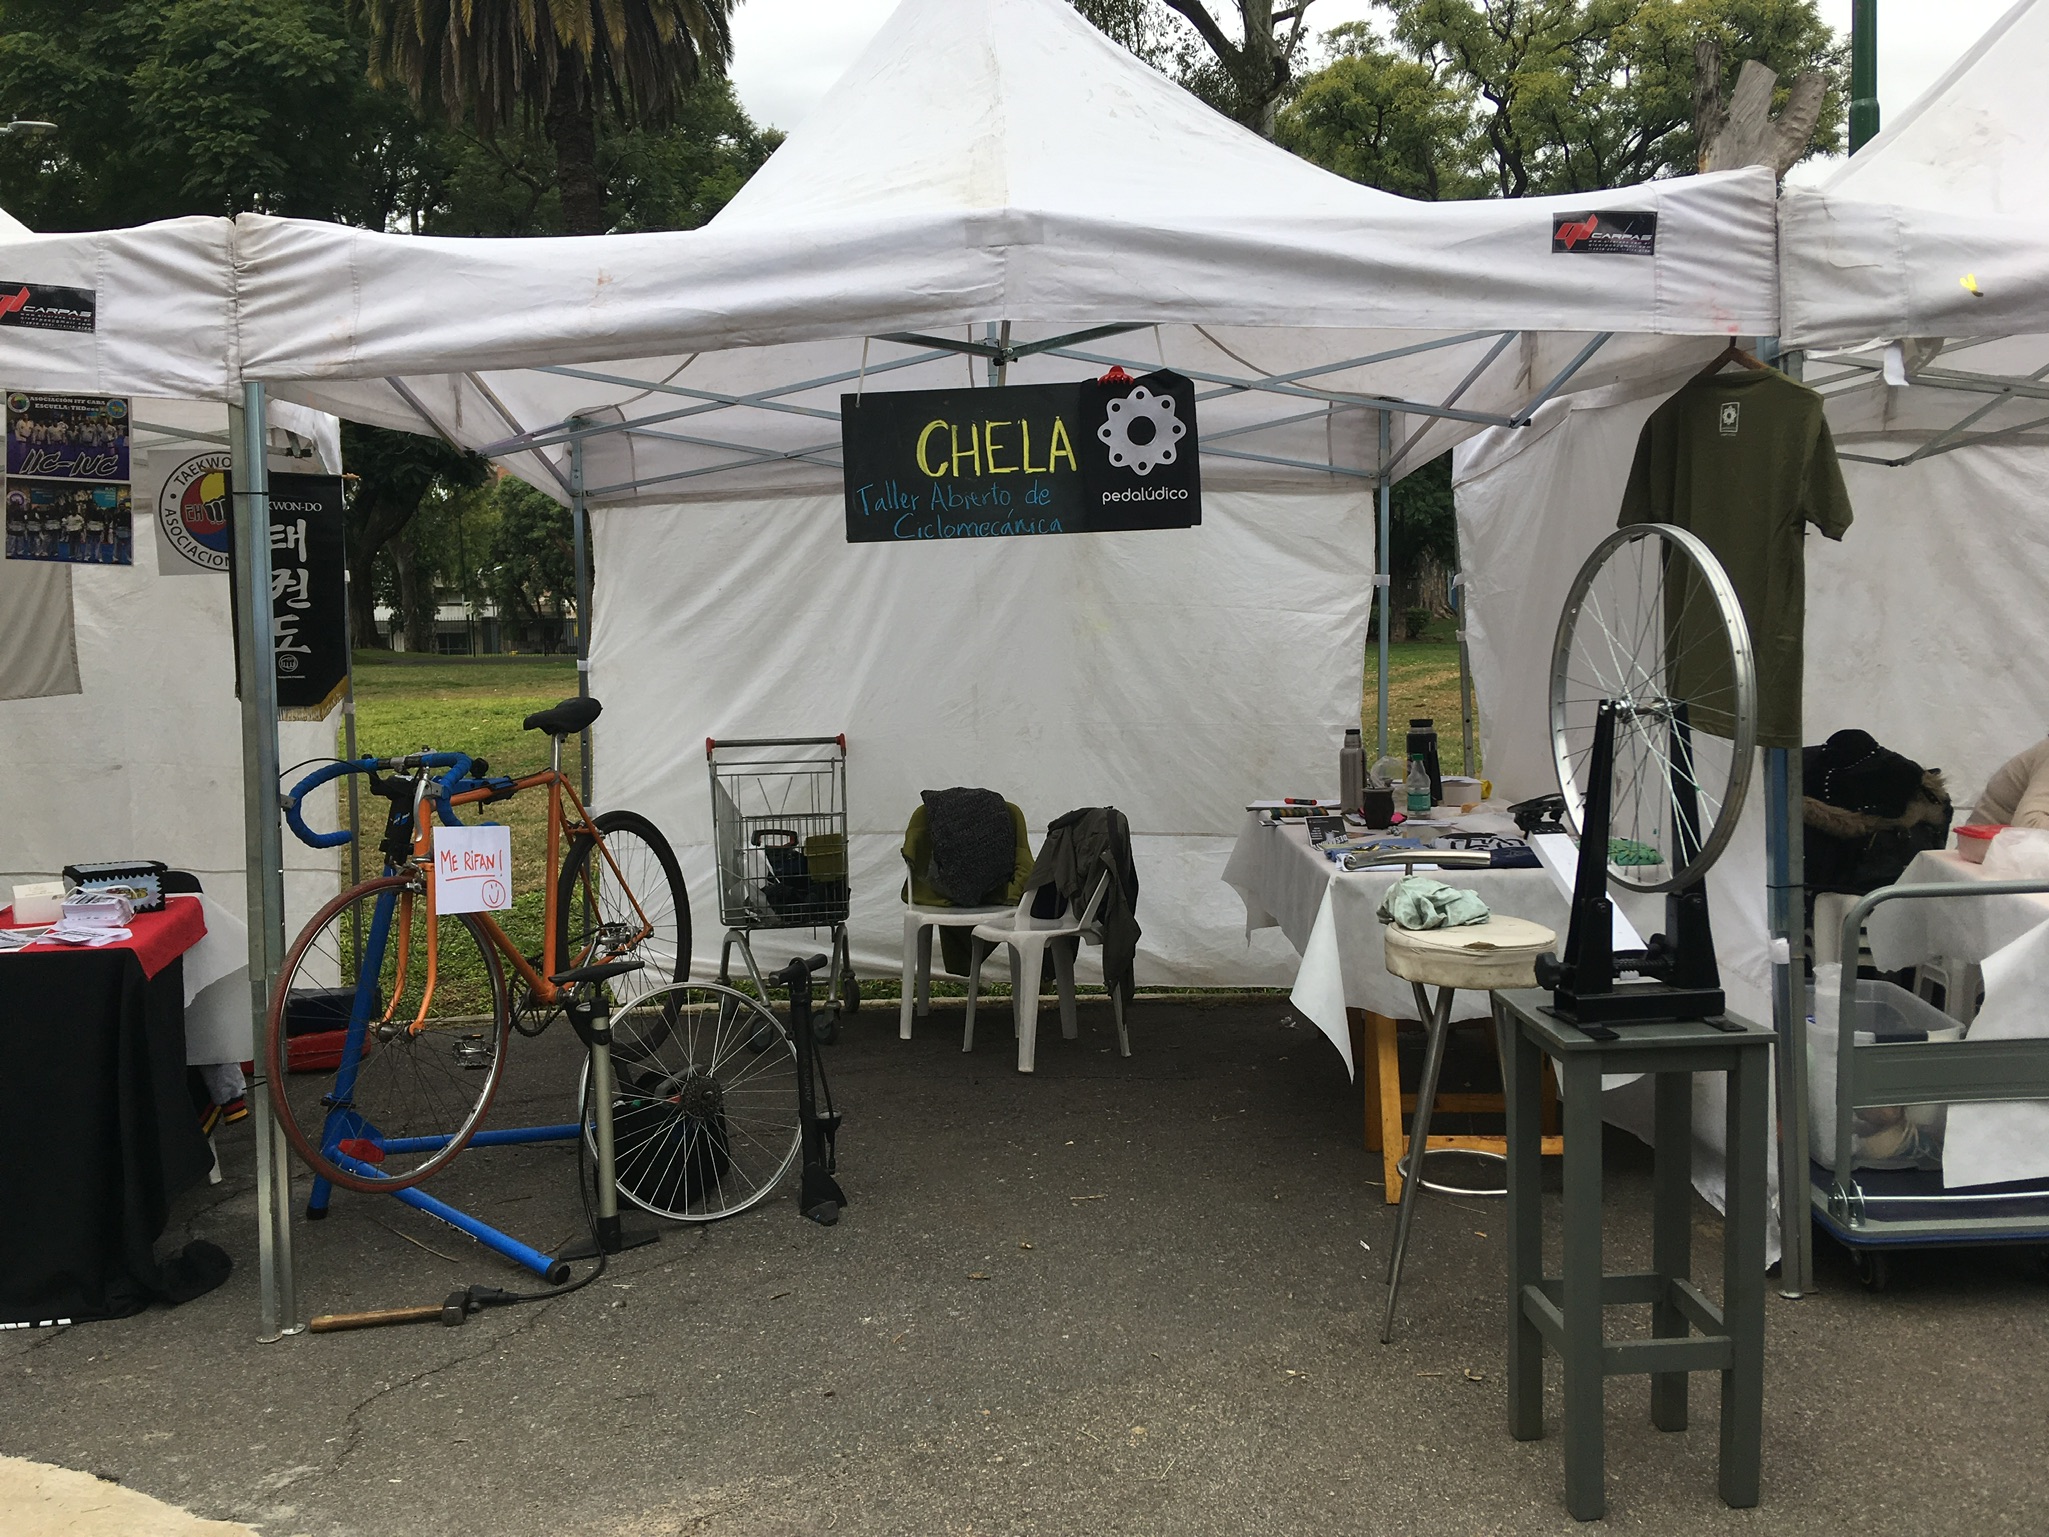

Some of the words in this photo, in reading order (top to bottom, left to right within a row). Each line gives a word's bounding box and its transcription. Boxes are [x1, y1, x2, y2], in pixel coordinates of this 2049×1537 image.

[1591, 232, 1653, 241] CARPAS
[22, 305, 92, 318] CARPAS
[916, 416, 1077, 477] CHELA
[856, 480, 920, 516] Taller
[930, 481, 1012, 512] Abierto
[1024, 479, 1051, 506] de
[1102, 486, 1188, 505] pedalúdico
[894, 508, 1063, 540] Ciclomecánica
[440, 849, 459, 875] ME
